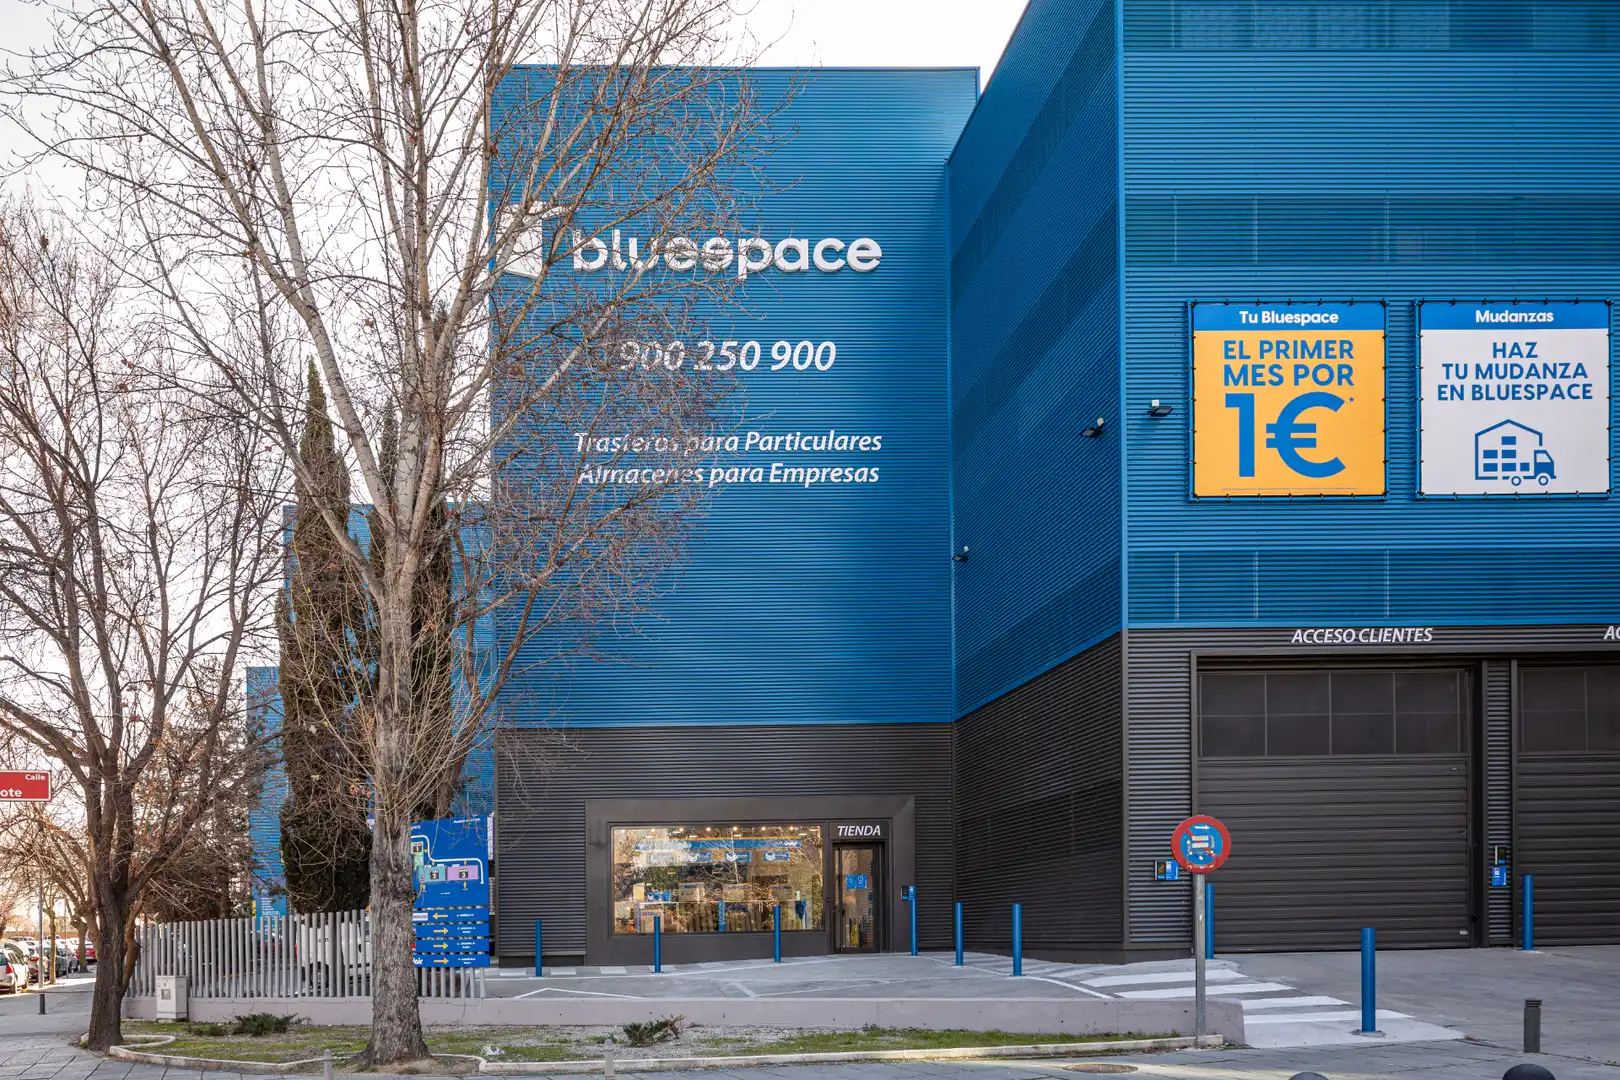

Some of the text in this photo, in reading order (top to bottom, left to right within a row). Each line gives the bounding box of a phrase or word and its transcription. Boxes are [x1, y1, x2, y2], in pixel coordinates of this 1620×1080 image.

[572, 229, 883, 280] bluespace
[1239, 310, 1339, 326] Tu Bluespace
[1475, 309, 1554, 323] Mudanzas
[619, 340, 837, 371] 900 250 900
[1223, 339, 1354, 360] EL PRIMER
[1492, 341, 1538, 359] HAZ
[1223, 363, 1354, 387] MES POR
[1442, 362, 1588, 380] TU MUDANZA
[1437, 383, 1593, 401] EN BLUESPACE
[683, 436, 739, 458] para
[744, 430, 883, 452] Particulares
[576, 462, 880, 489] Almacenes para Empresas
[1291, 627, 1434, 644] ACCESO CLIENTES
[25, 773, 46, 781] Calle
[837, 825, 881, 837] TIENDA
